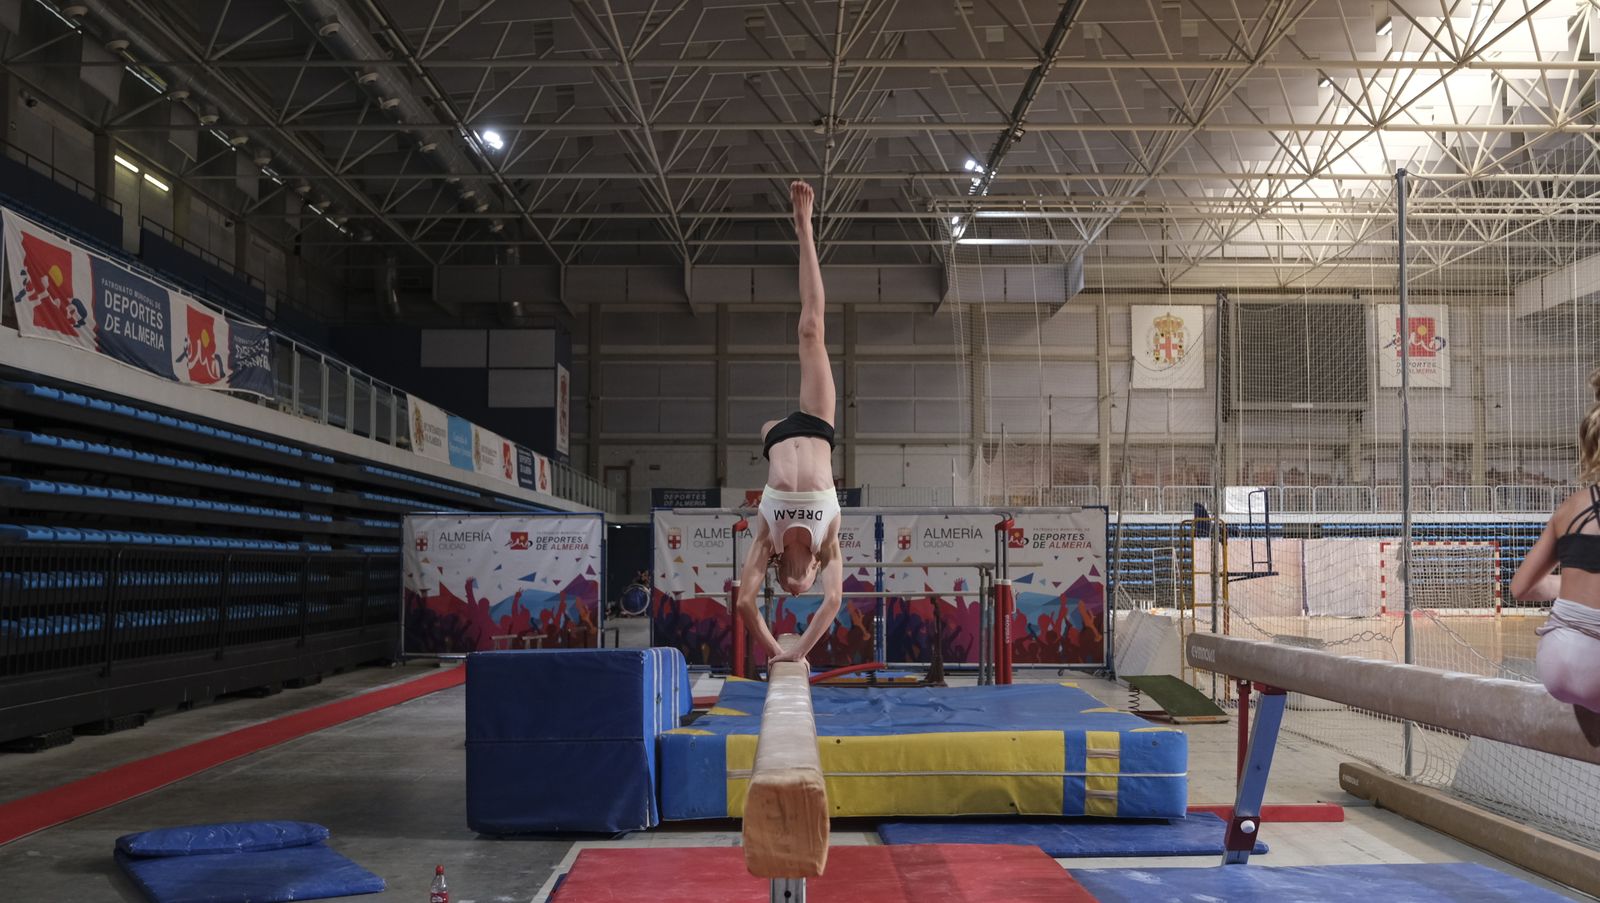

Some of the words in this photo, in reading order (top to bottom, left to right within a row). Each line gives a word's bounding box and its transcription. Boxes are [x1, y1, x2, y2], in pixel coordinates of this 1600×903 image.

[104, 289, 163, 330] DEPORTES
[104, 313, 121, 335] DE
[124, 320, 165, 352] ALMERIA
[774, 509, 823, 521] DREAM
[439, 529, 492, 542] ALMERÍA
[694, 527, 753, 539] ALMEA
[923, 525, 983, 539] ALMERÍA
[536, 536, 583, 544] DEPORTES
[1033, 533, 1085, 541] DEPORTES
[438, 543, 466, 551] CIUDAD
[536, 543, 548, 551] DE
[693, 540, 724, 548] CIUDAD
[923, 540, 954, 548] CIUDAD
[1033, 541, 1046, 549] DE
